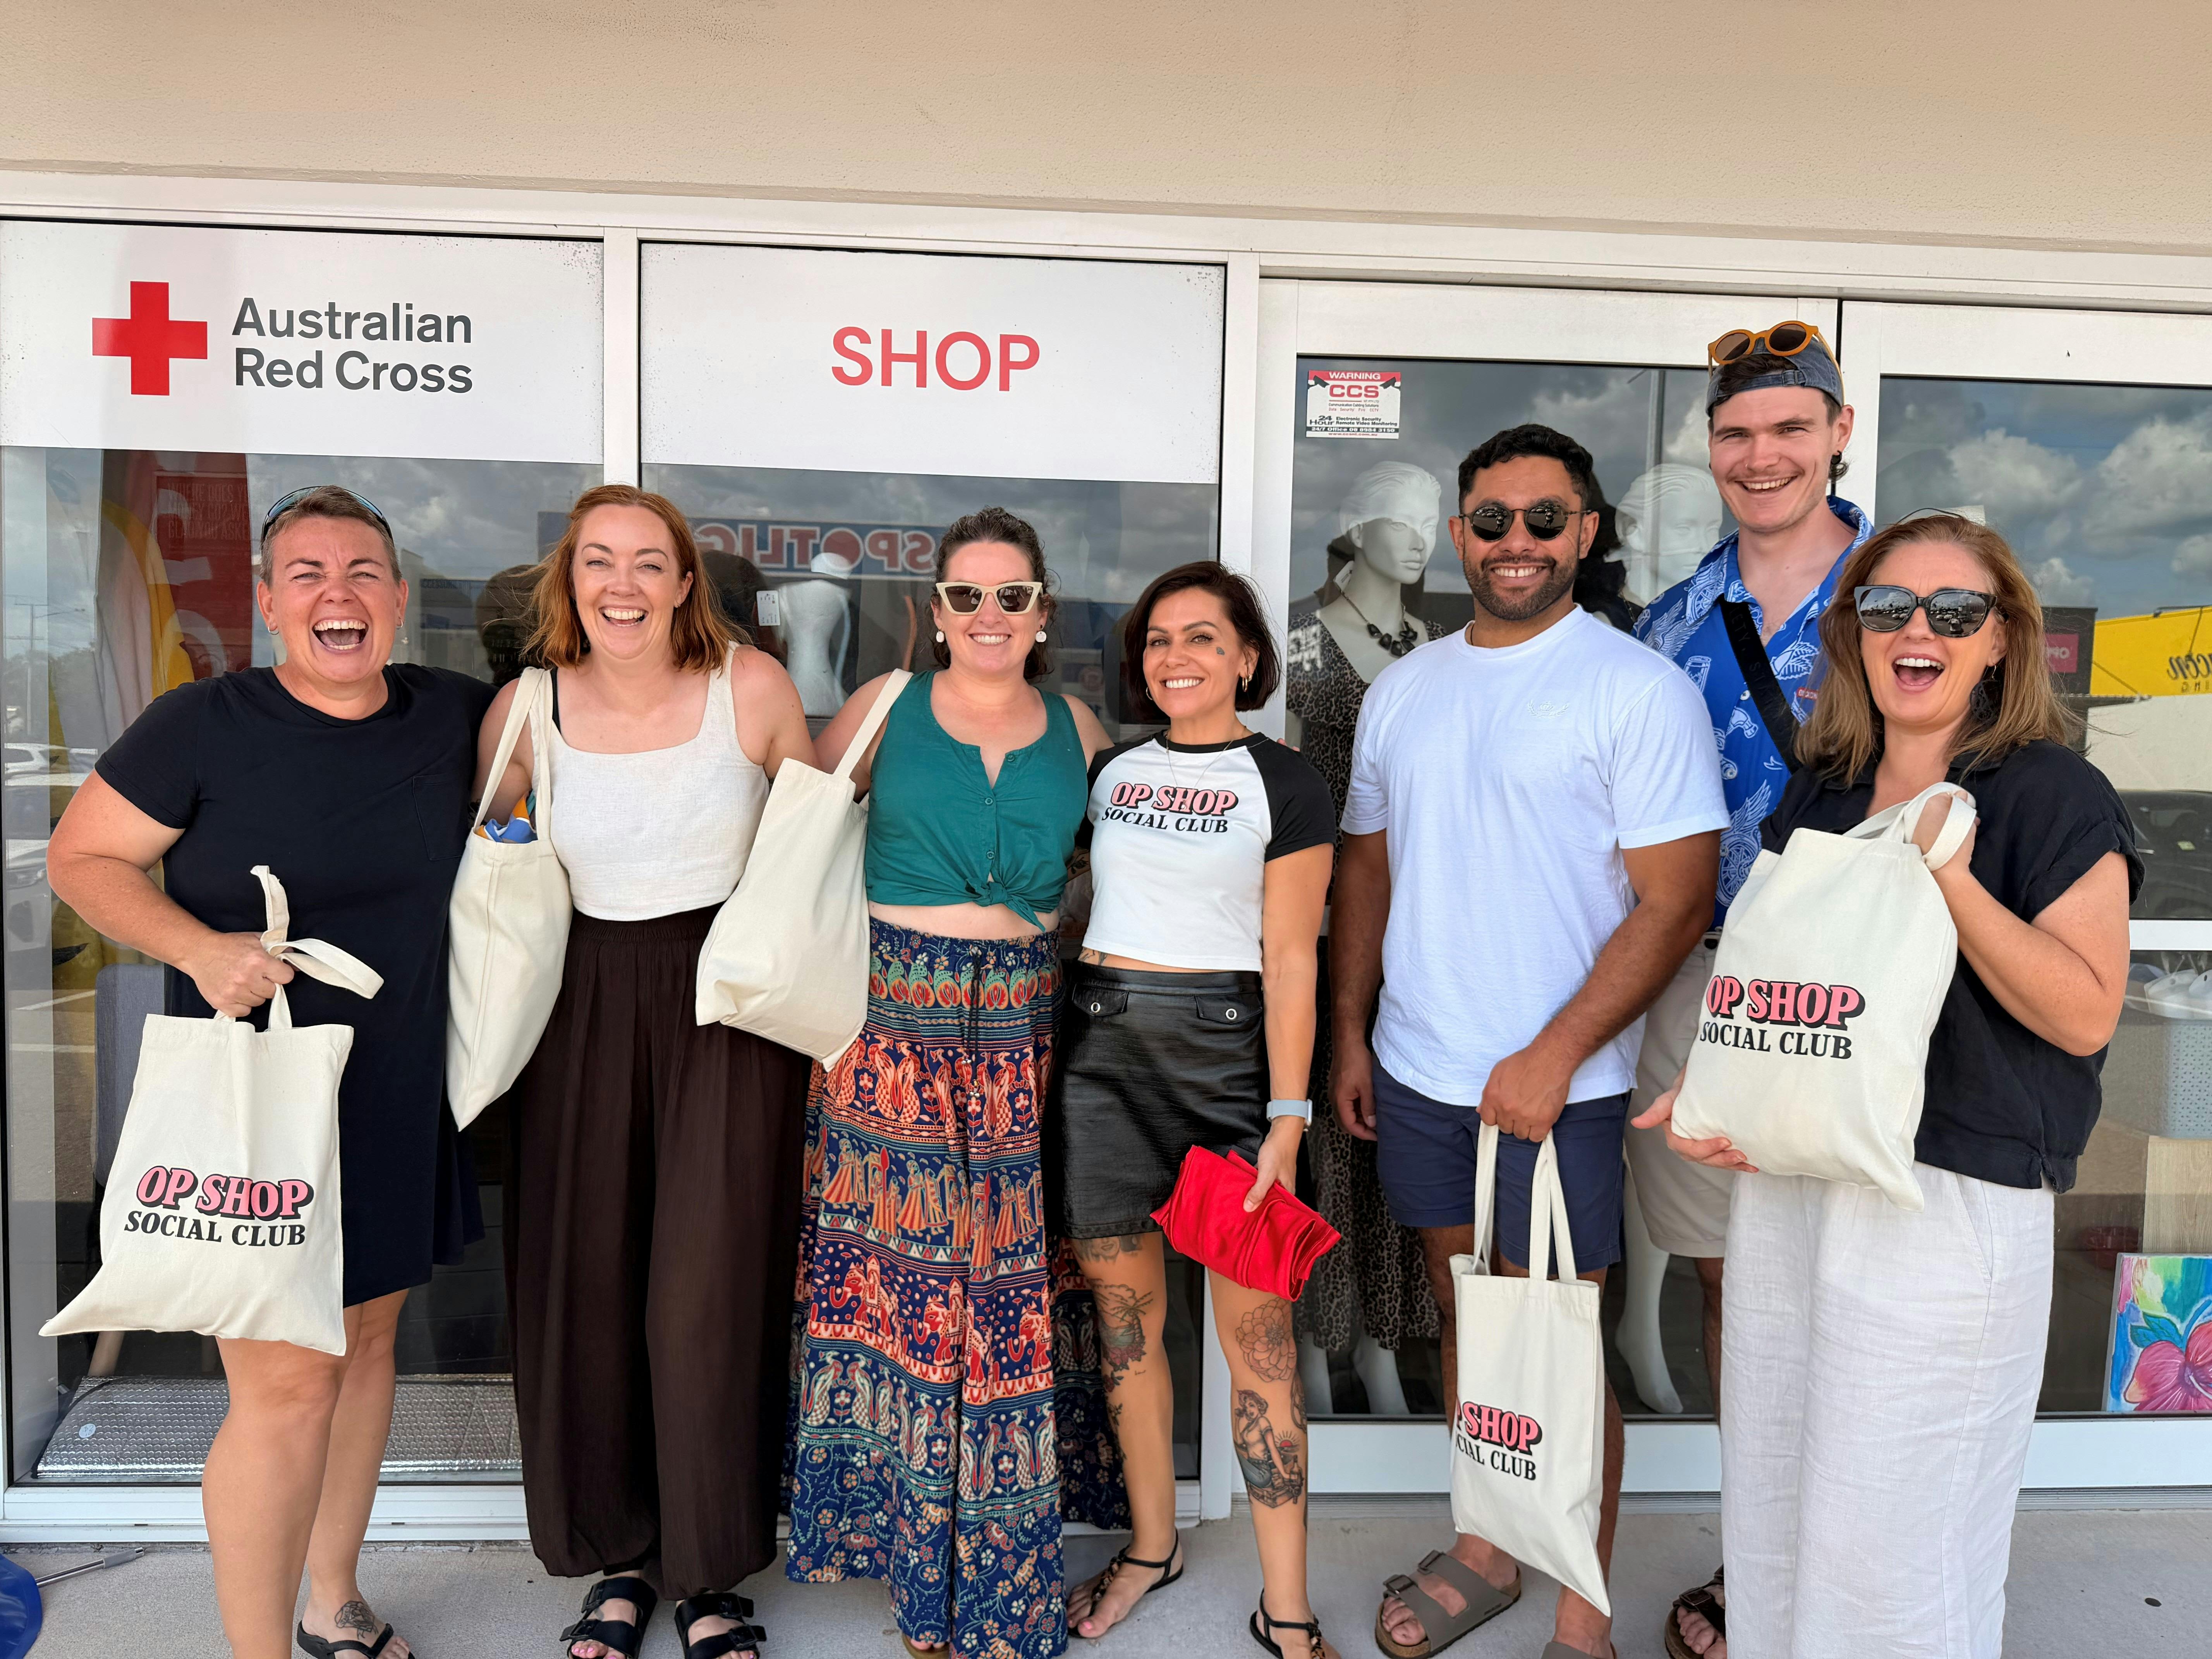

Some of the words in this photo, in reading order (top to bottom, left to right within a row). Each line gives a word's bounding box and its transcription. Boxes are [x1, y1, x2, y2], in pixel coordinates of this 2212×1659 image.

[232, 297, 471, 343] Australian
[236, 347, 323, 388] Red
[336, 350, 473, 393] Cross
[831, 326, 1039, 391] SHOP
[1329, 372, 1381, 380] WARNING
[1329, 384, 1379, 398] CCS
[1101, 807, 1168, 830] SOCIAL
[1175, 817, 1228, 833] CLUB
[1110, 782, 1153, 809] OP
[1151, 785, 1239, 816] SHOP
[1706, 975, 1745, 1019] OP
[1747, 979, 1865, 1031] SHOP
[1700, 1021, 1771, 1052] SOCIAL
[1779, 1031, 1852, 1060] CLUB
[136, 1166, 199, 1210] OP
[195, 1174, 314, 1221] SHOP
[124, 1211, 222, 1243] SOCIAL
[232, 1224, 306, 1247] CLUB
[1462, 1401, 1542, 1456] SHOP
[1455, 1432, 1485, 1465] CIAL
[1490, 1449, 1536, 1481] CLUB
